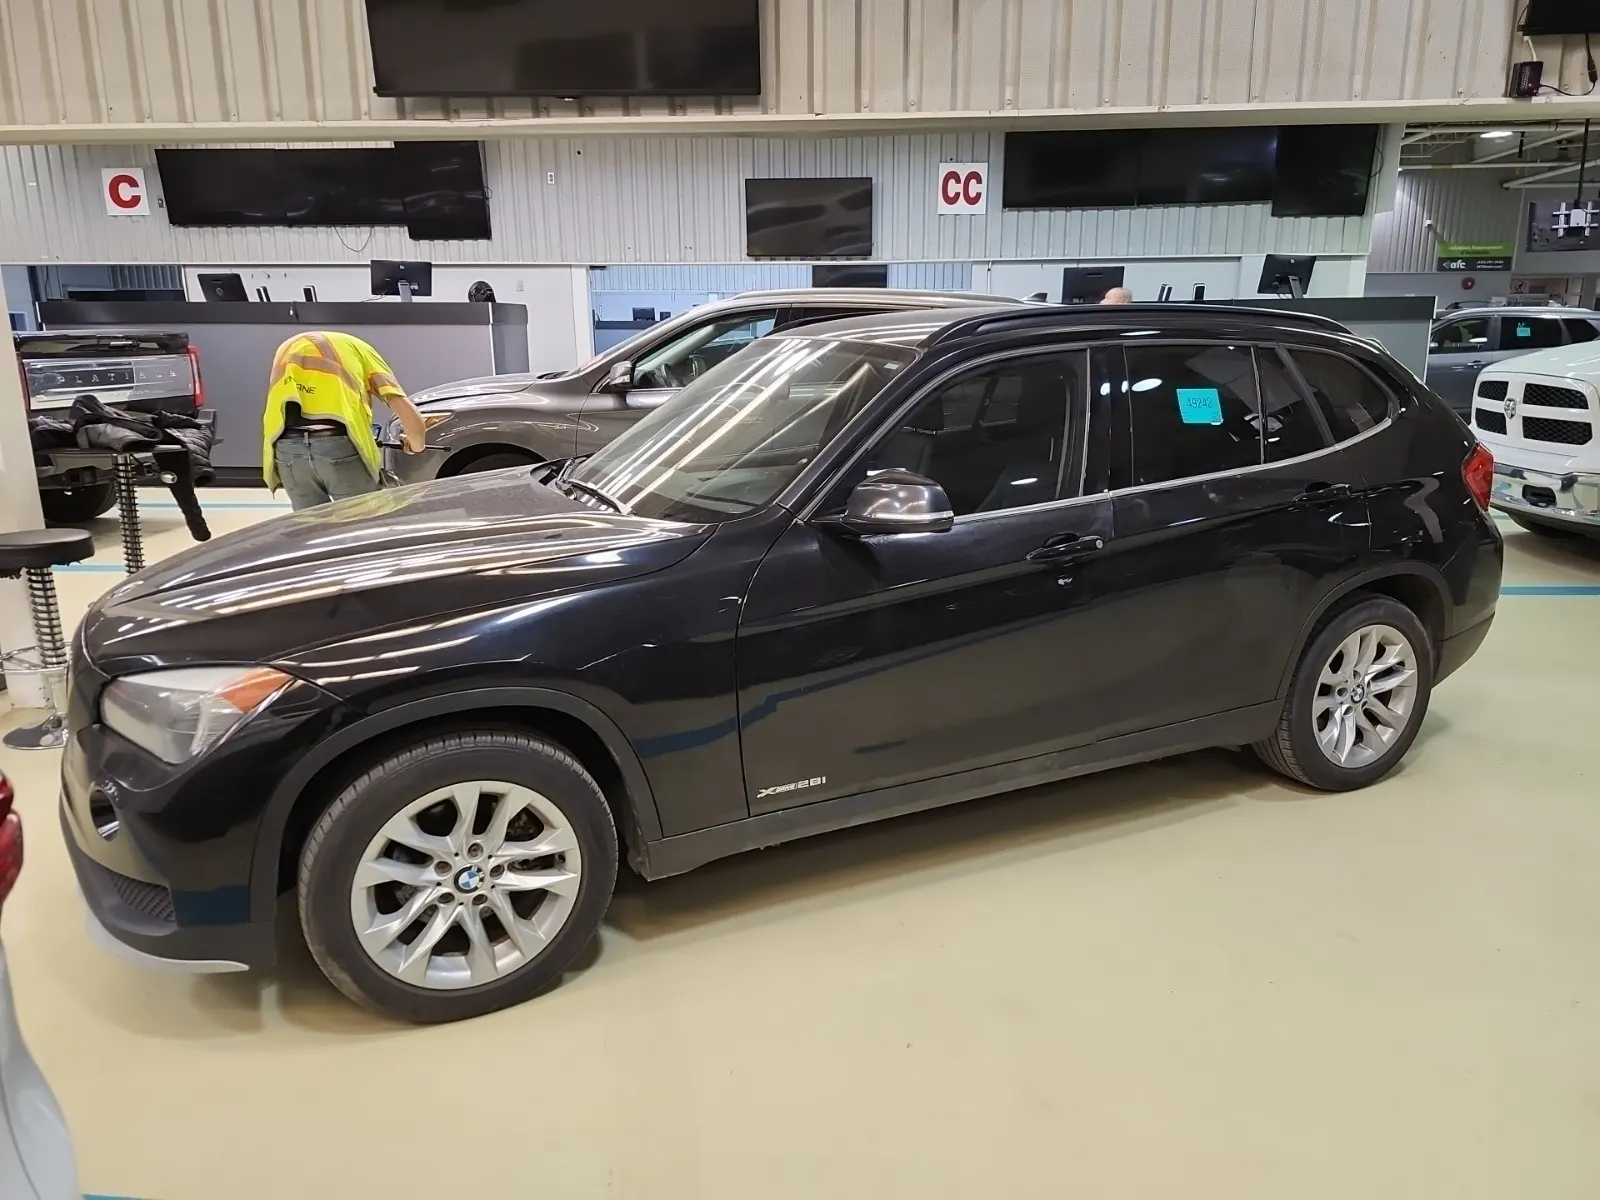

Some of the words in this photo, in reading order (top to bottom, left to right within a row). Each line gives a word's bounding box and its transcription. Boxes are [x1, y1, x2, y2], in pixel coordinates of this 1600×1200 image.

[111, 174, 142, 208] C
[942, 171, 983, 205] CC
[1450, 260, 1466, 269] afc
[1187, 397, 1213, 409] 49242
